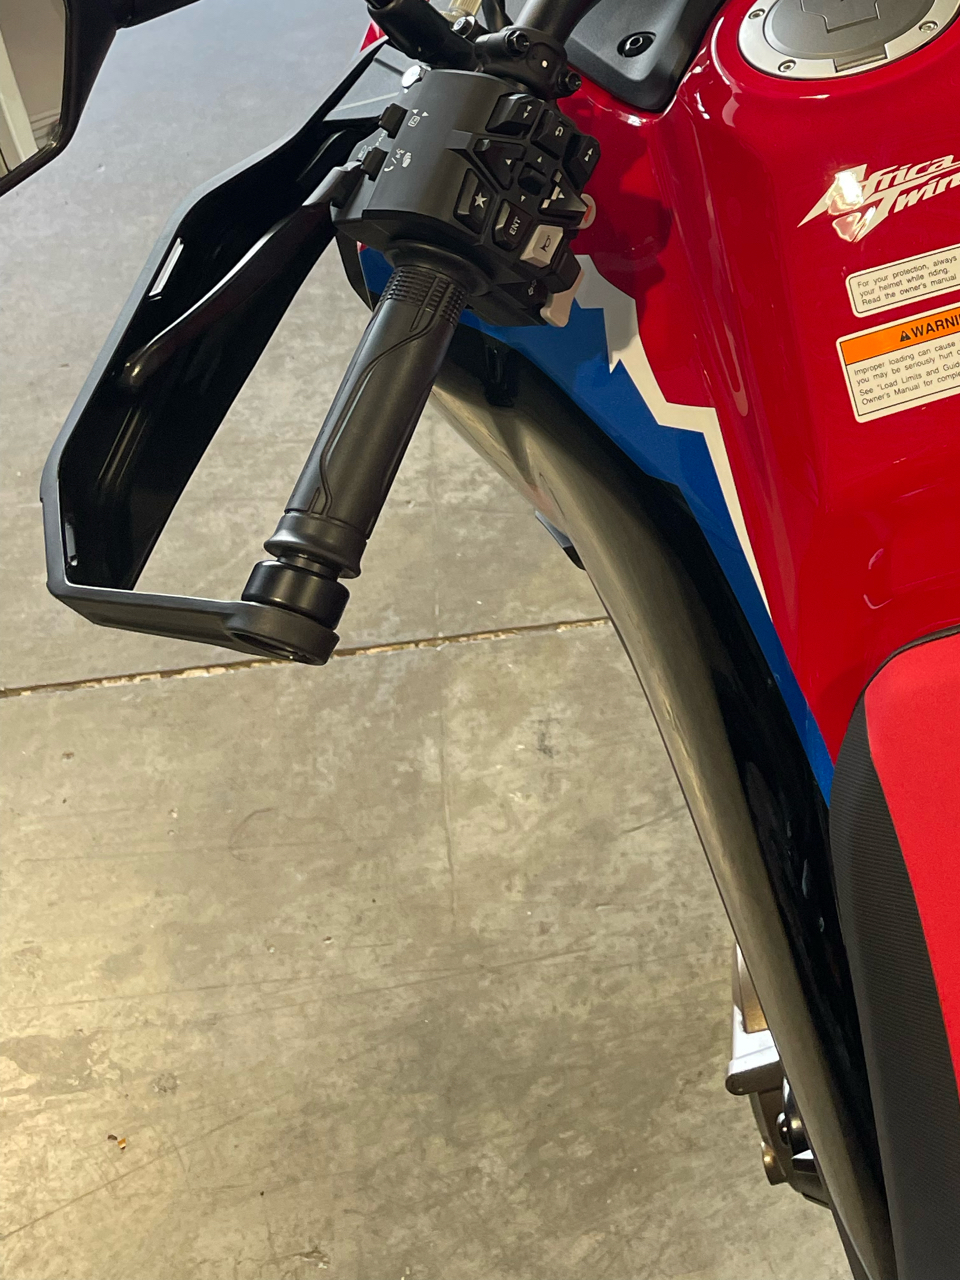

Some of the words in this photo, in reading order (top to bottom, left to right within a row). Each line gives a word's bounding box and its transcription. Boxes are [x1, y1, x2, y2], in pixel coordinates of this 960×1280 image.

[509, 216, 521, 235] ENT
[857, 280, 870, 288] For
[873, 275, 889, 285] your
[893, 264, 929, 278] protection,
[933, 255, 957, 267] always
[860, 288, 875, 298] your
[879, 280, 903, 292] helmet
[906, 274, 924, 284] while
[928, 267, 949, 278] riding.
[862, 295, 881, 306] Read
[884, 291, 896, 299] the
[899, 283, 927, 295] owner's
[930, 274, 957, 286] manual
[854, 362, 885, 375] Improper
[888, 353, 915, 365] loading
[918, 349, 931, 357] can
[934, 342, 956, 352] cause
[857, 377, 870, 387] you
[873, 371, 888, 380] may
[892, 367, 901, 375] be
[904, 357, 936, 371] seriously
[939, 351, 953, 361] hurt
[860, 387, 874, 397] See
[877, 380, 898, 391] "Load
[902, 373, 923, 384] Limits
[925, 368, 940, 377] and
[862, 392, 891, 405] Owner's
[894, 383, 921, 395] Manual
[923, 378, 934, 387] for
